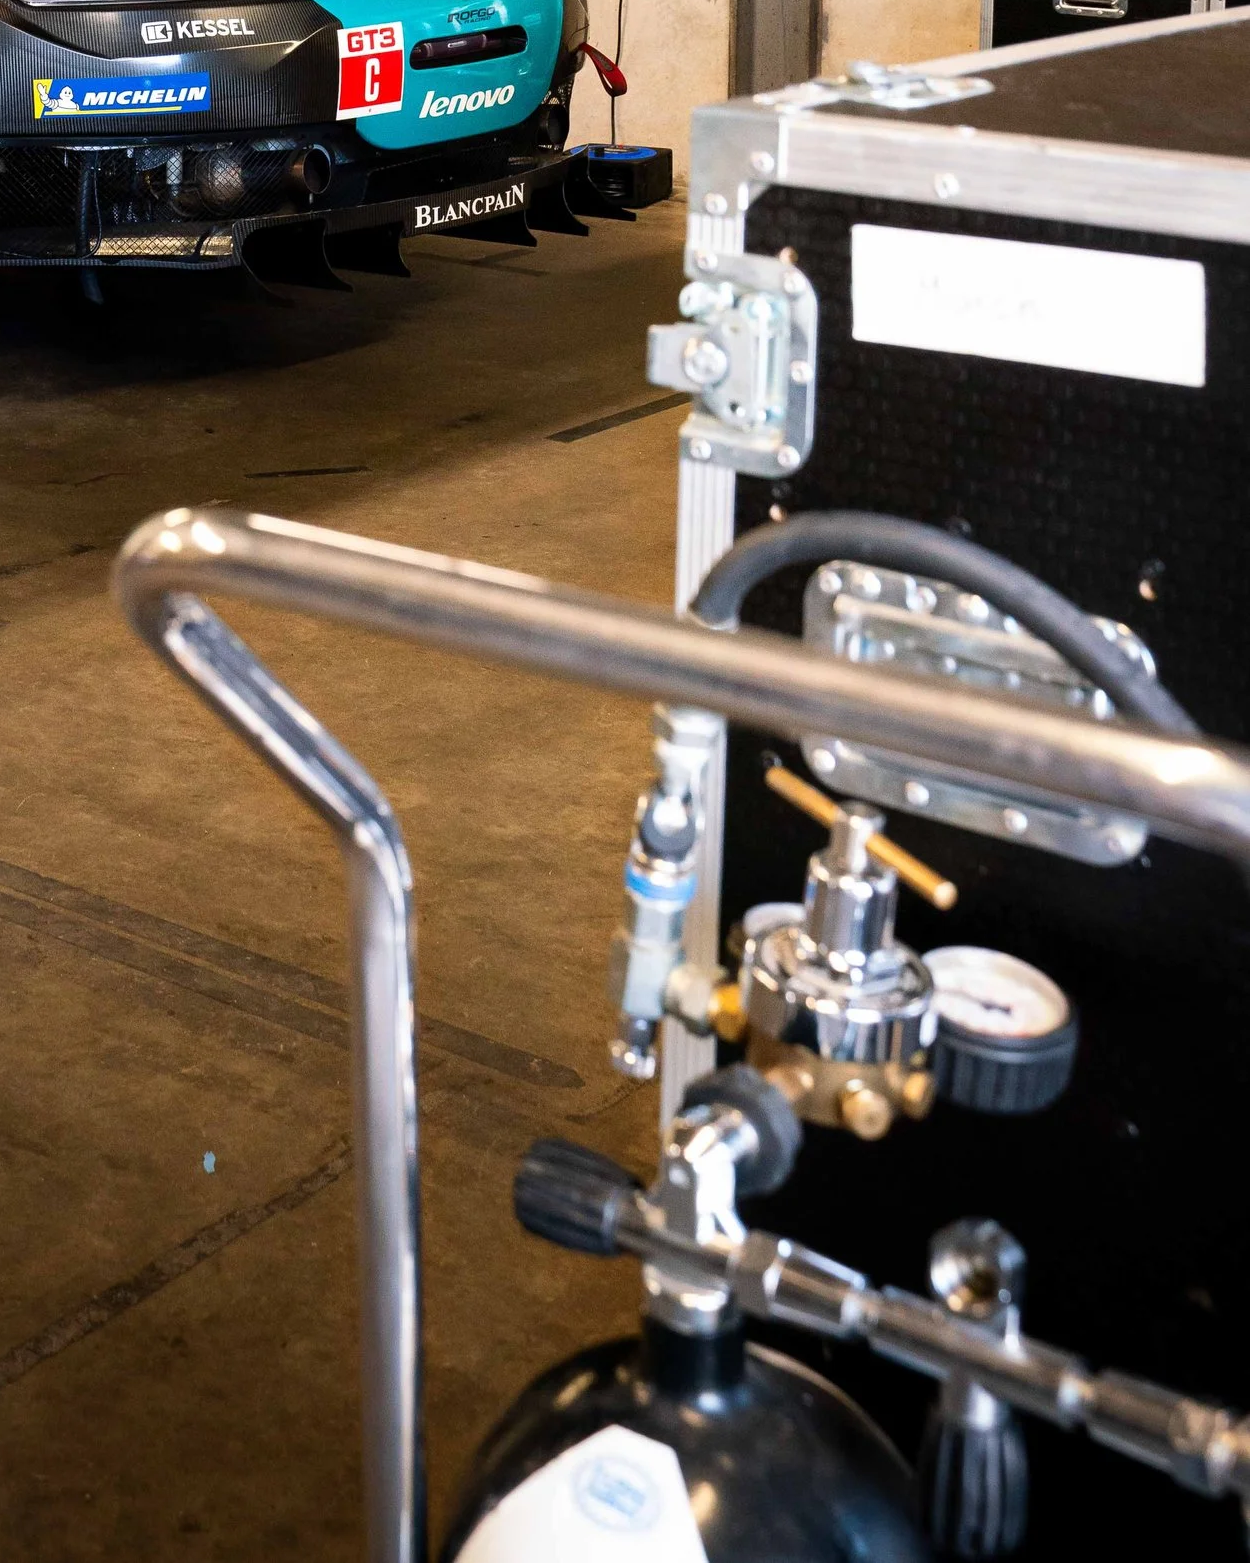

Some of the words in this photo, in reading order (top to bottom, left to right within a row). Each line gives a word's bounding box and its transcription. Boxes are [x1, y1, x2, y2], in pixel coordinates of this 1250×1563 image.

[176, 18, 255, 39] KESSEL
[347, 27, 396, 53] GT3
[365, 58, 381, 102] C
[82, 86, 207, 107] MICHELIN
[419, 85, 515, 119] lenovo
[414, 183, 525, 228] BLANCPAIN
